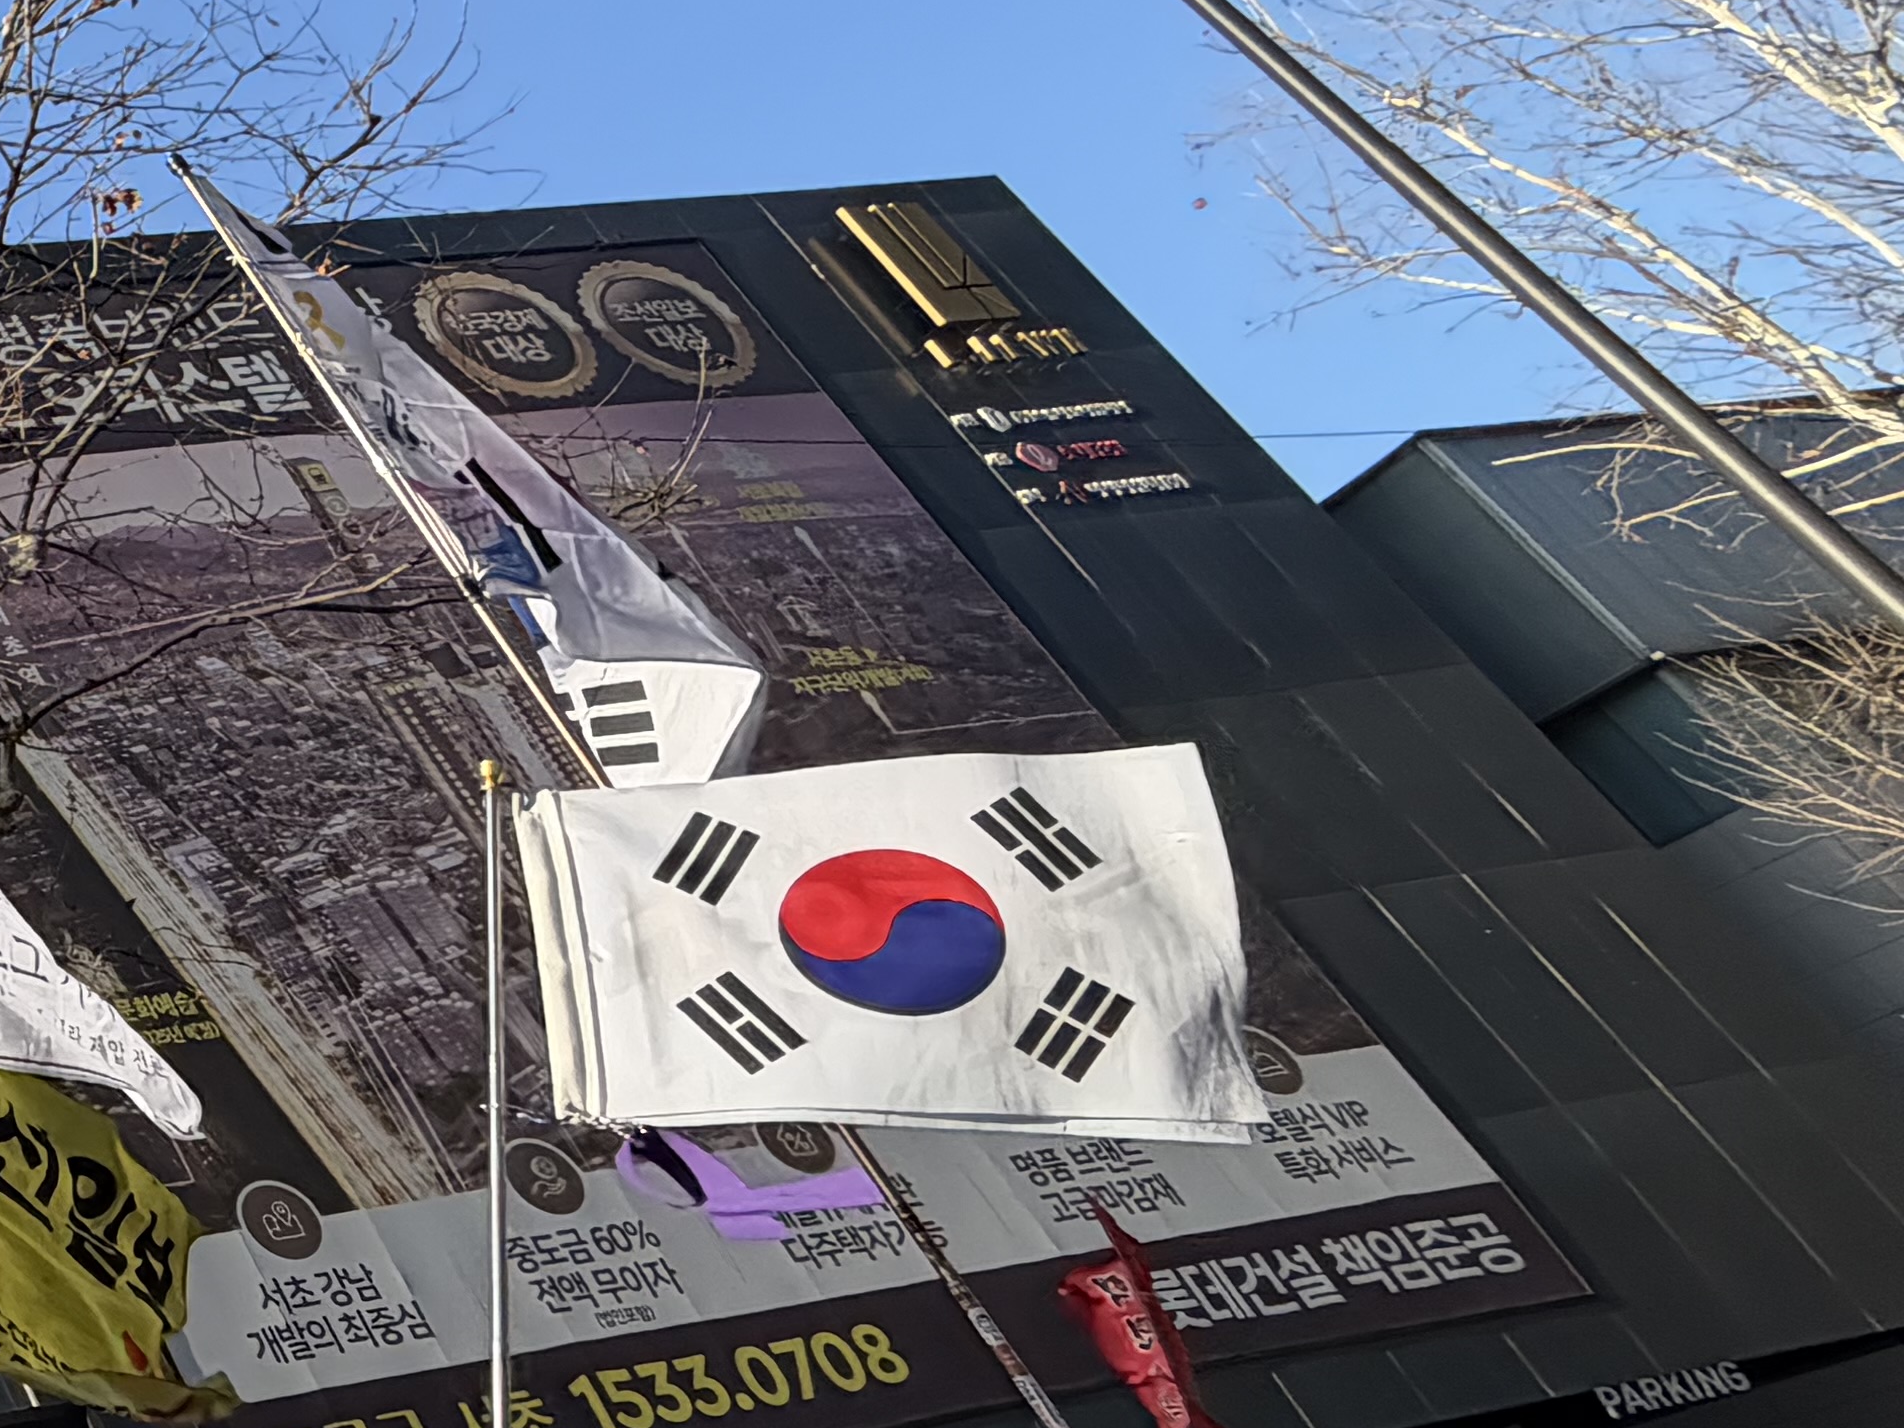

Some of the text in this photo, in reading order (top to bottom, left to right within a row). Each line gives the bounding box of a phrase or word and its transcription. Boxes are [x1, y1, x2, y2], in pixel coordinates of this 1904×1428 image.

[482, 334, 553, 365] 대상
[1326, 1099, 1370, 1129] VIP
[1009, 1136, 1155, 1187] 명품 브랜드
[1282, 1134, 1415, 1183] 특화 서비스
[507, 1219, 661, 1274] 중도금 60%
[1150, 1246, 1347, 1332] 롯데건설
[1322, 1212, 1524, 1298] 책임준공
[259, 1263, 386, 1315] 서초 강남
[529, 1258, 685, 1315] 전액 무이자
[247, 1300, 436, 1365] 개발의 최중심
[1594, 1360, 1752, 1419] PARKING
